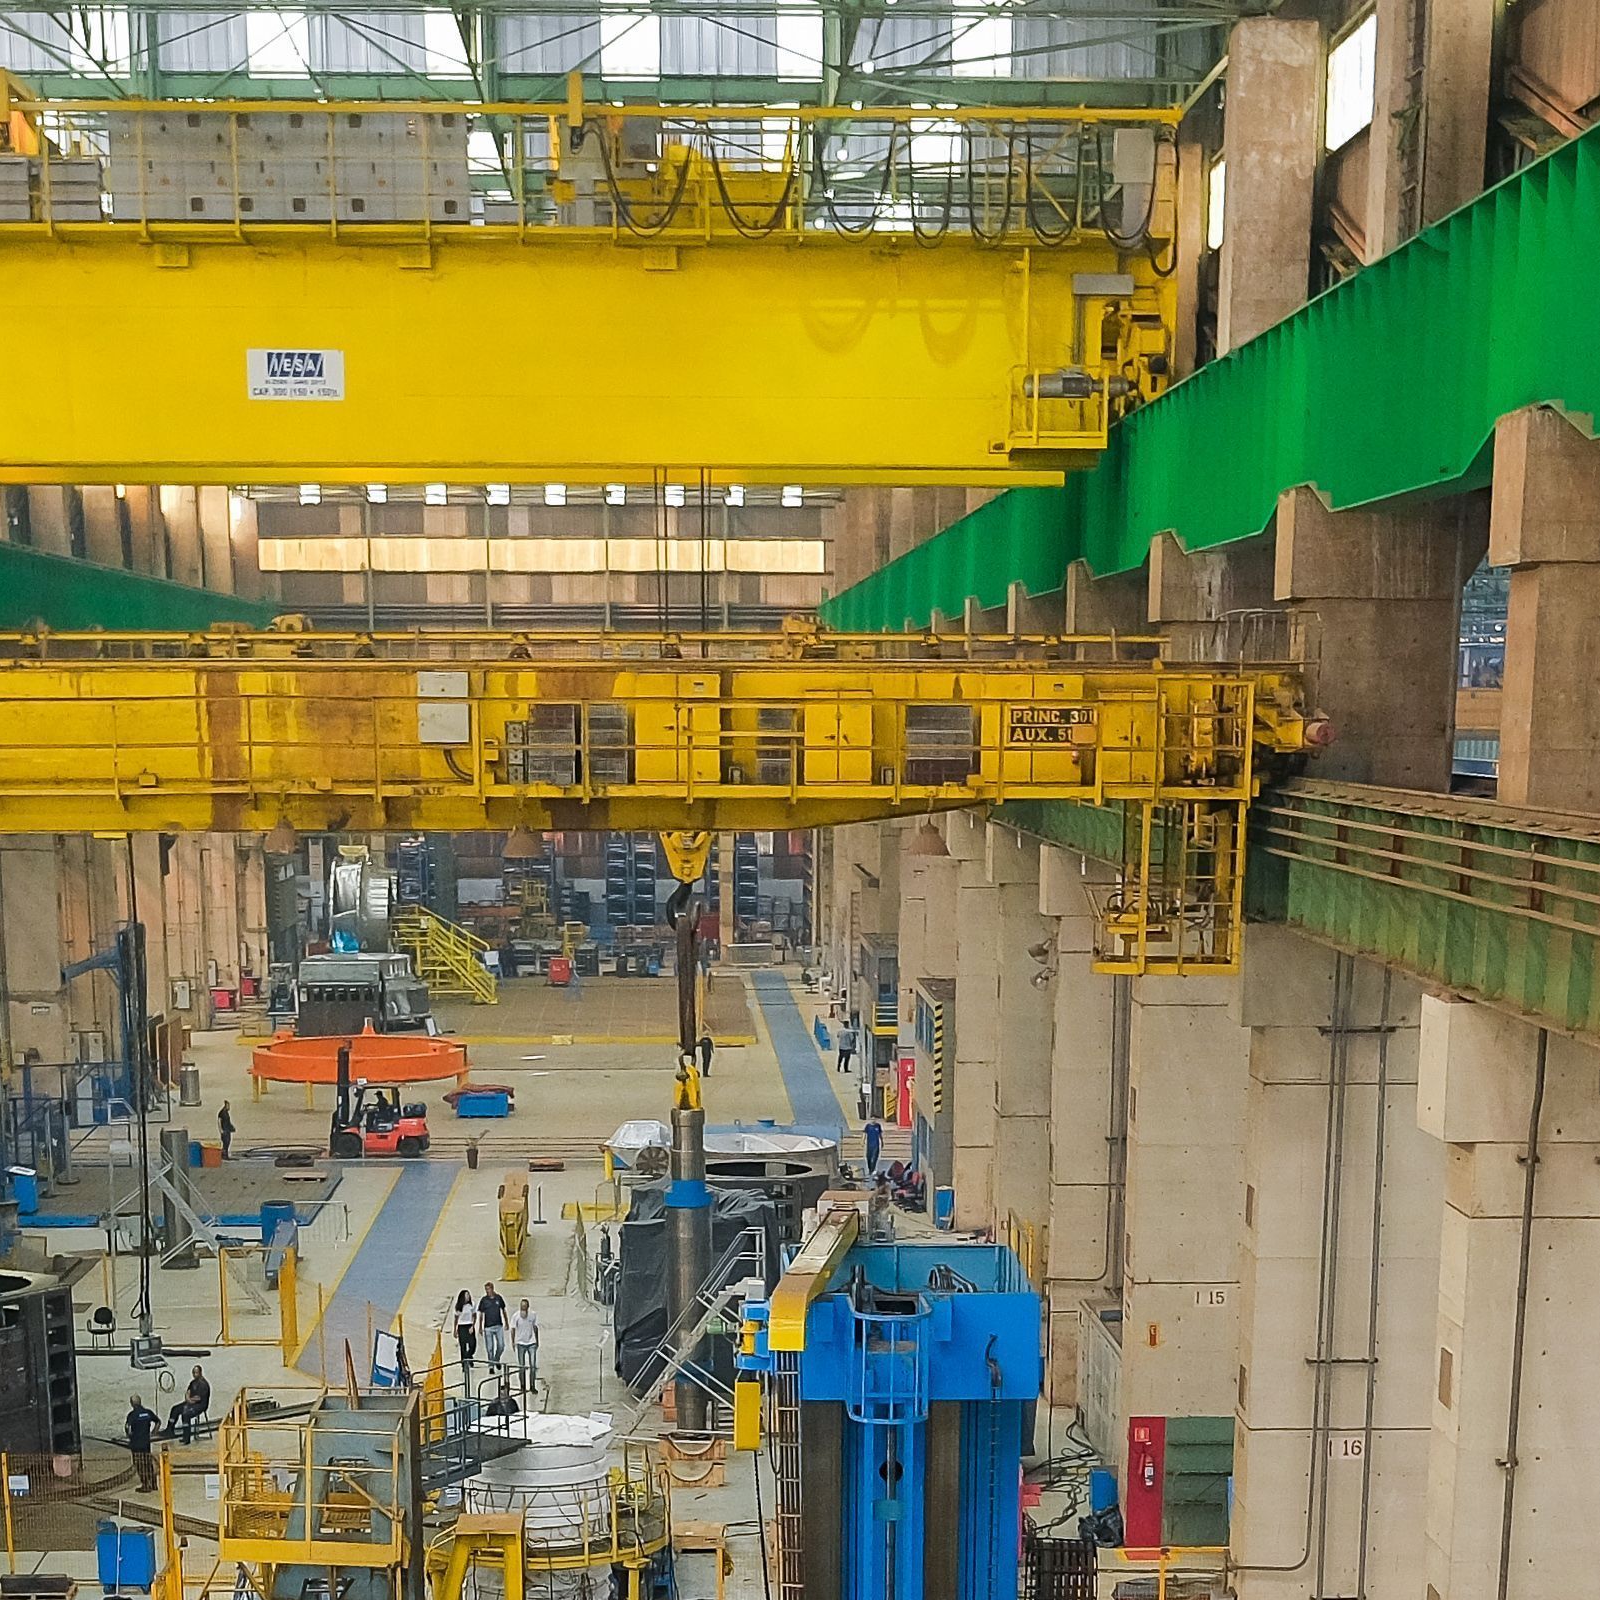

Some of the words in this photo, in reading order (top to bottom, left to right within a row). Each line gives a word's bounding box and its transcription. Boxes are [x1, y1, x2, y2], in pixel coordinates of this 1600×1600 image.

[1012, 710, 1066, 724] PRINC.
[1012, 728, 1054, 742] AUX.
[1343, 1439, 1362, 1456] 16
